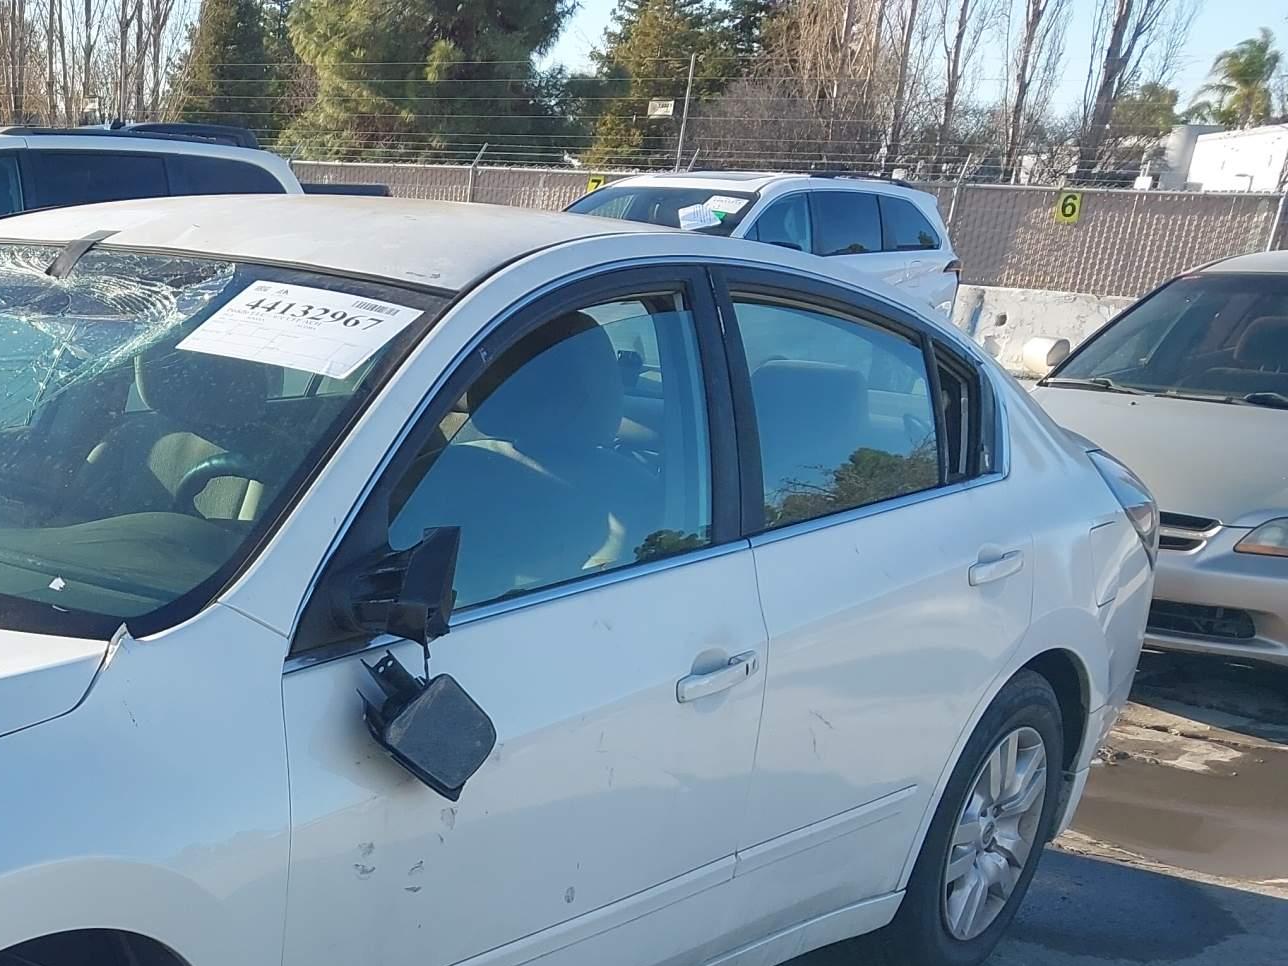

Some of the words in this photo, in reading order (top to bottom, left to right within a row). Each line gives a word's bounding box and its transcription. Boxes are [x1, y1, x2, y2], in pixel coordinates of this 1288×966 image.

[591, 179, 602, 189] 7
[1061, 194, 1077, 217] 6
[245, 298, 385, 331] 44132967
